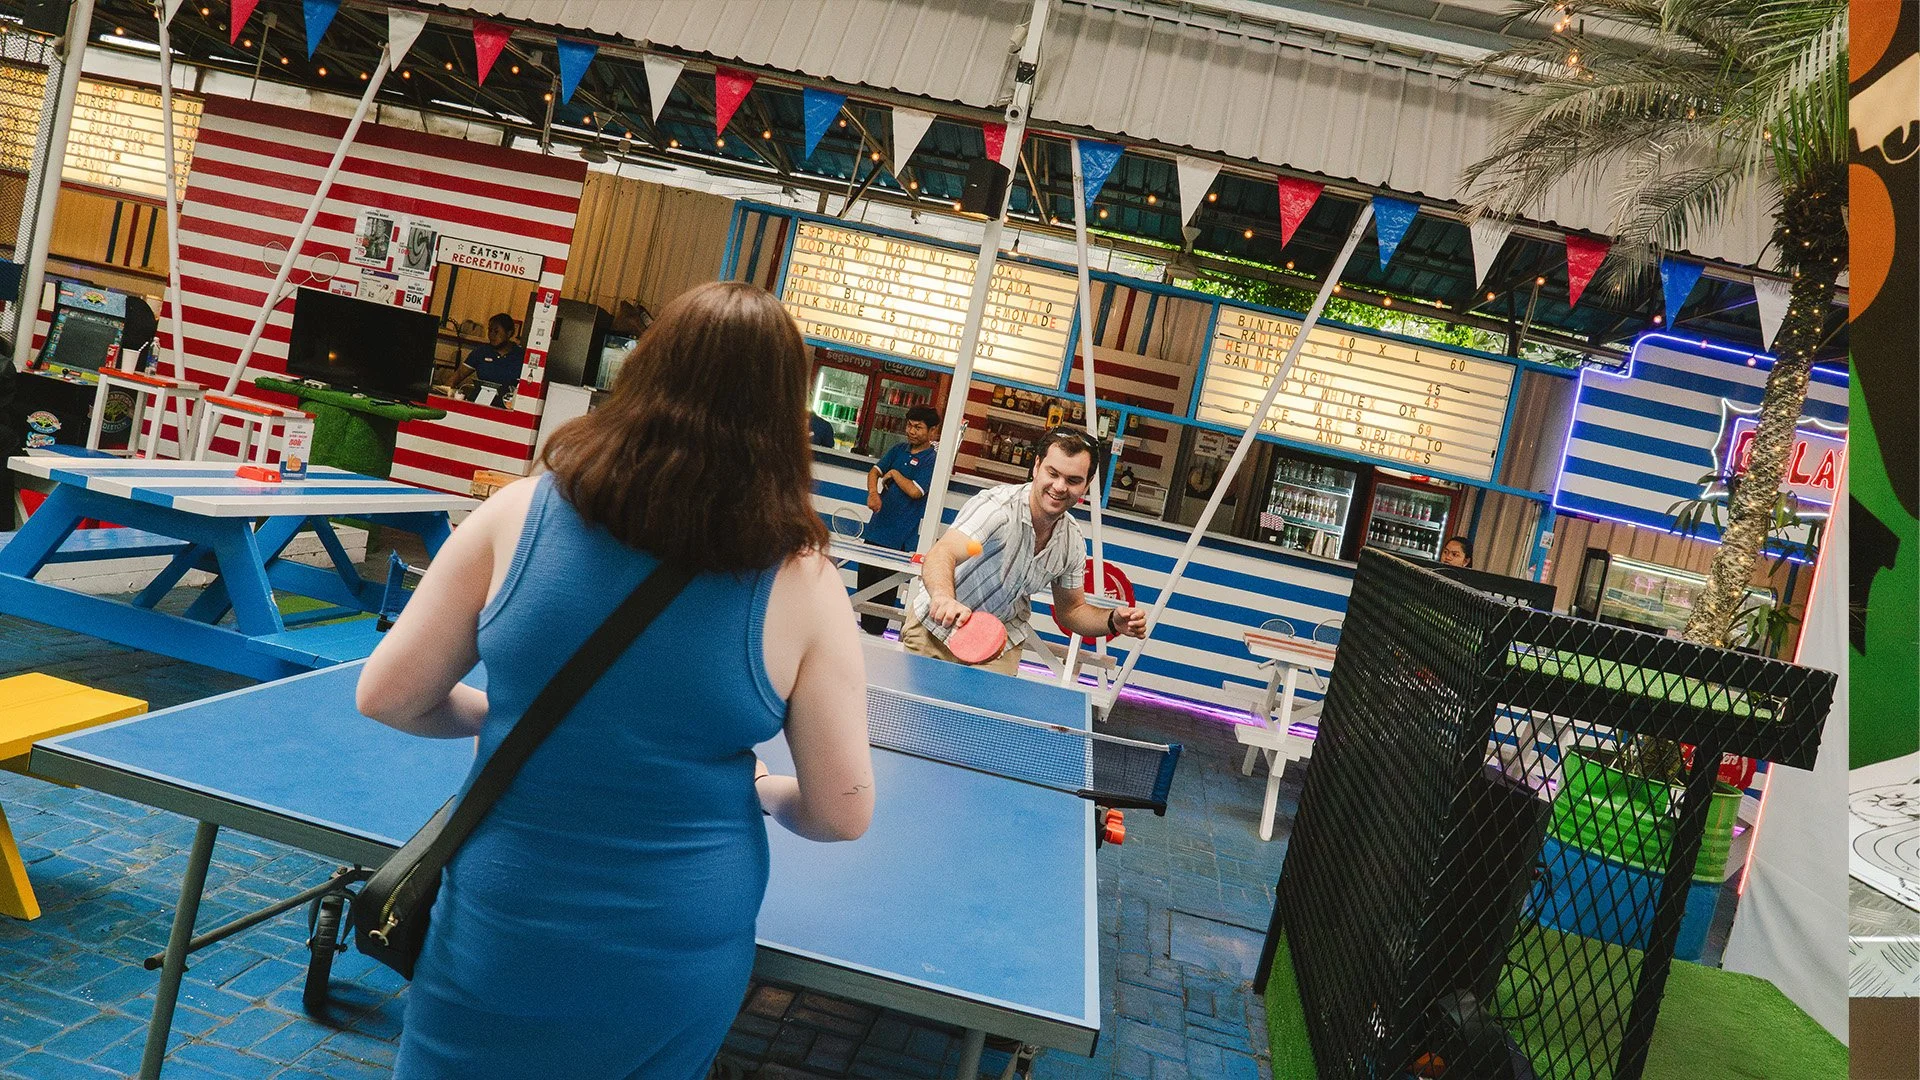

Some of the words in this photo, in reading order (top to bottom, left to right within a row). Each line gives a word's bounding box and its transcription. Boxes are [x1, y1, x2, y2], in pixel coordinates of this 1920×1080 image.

[133, 92, 176, 111] BURGR
[186, 103, 198, 113] 80
[89, 122, 154, 143] GUACAMOLE
[452, 253, 526, 276] RECREATIONS
[798, 224, 870, 248] ESPRESSO
[885, 242, 944, 263] MARTINI
[997, 263, 1023, 280] OKO
[793, 263, 848, 285] APEROL
[800, 240, 845, 257] VODKA
[855, 250, 906, 271] MOJITO
[989, 276, 1031, 295] OLADA
[790, 277, 832, 294] HONEY
[820, 256, 845, 271] GIN
[1029, 298, 1052, 314] 110
[405, 293, 423, 304] 50K
[785, 290, 820, 308] MILK
[881, 311, 896, 323] 45
[949, 321, 963, 337] TE
[805, 321, 872, 346] LEMONADE
[1238, 315, 1299, 337] BINTANG
[1339, 337, 1356, 349] 40
[1379, 344, 1386, 355] X
[1414, 351, 1420, 362] L
[1450, 358, 1466, 372] 60
[1225, 340, 1300, 365] HEINEKN
[1427, 383, 1441, 396] 45
[1337, 350, 1353, 363] 40
[1224, 354, 1249, 369] SAN
[1424, 396, 1439, 410] 45
[1261, 375, 1288, 392] RD
[1399, 403, 1417, 418] OR
[1260, 421, 1277, 432] AX
[1315, 431, 1342, 445] AND
[1360, 439, 1431, 464] SERVICES
[1418, 423, 1432, 437] 69
[1427, 438, 1443, 452] TO
